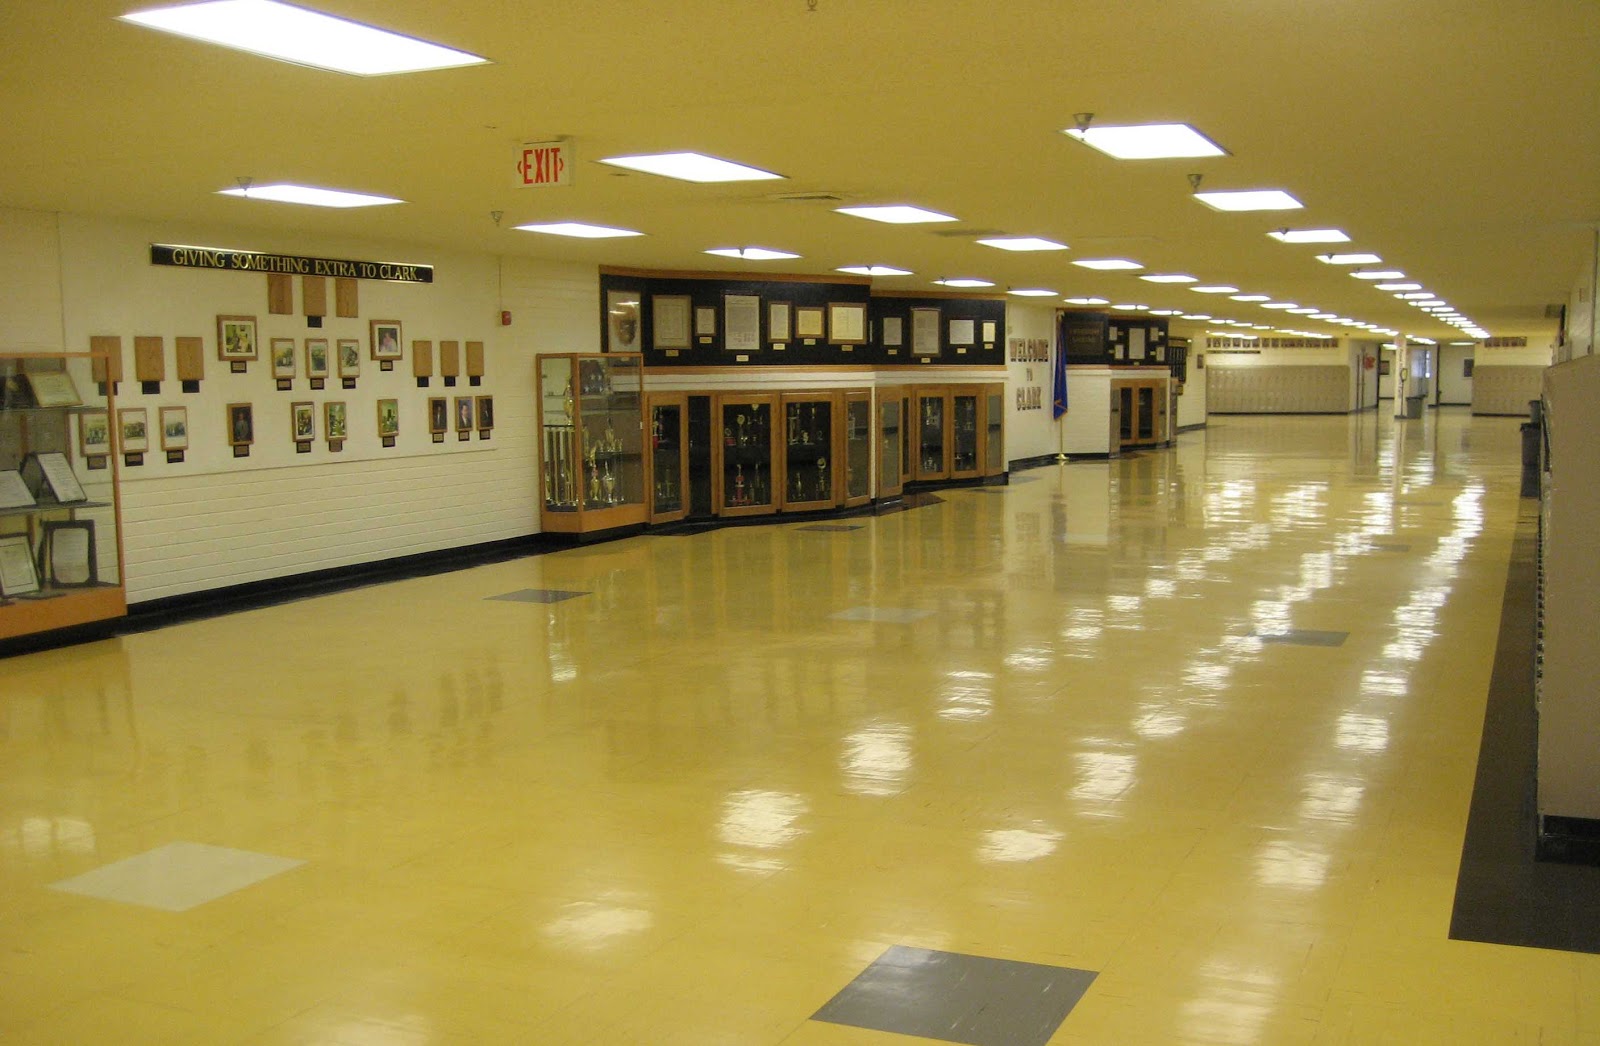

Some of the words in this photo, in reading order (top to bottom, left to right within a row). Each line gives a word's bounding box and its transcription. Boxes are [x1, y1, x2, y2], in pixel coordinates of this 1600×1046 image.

[523, 148, 561, 184] EXIT
[172, 249, 226, 268] GIVING
[231, 253, 309, 274] SOMETHING
[315, 260, 357, 277] EXTRA
[360, 263, 376, 278] TO
[380, 265, 418, 280] CLARK
